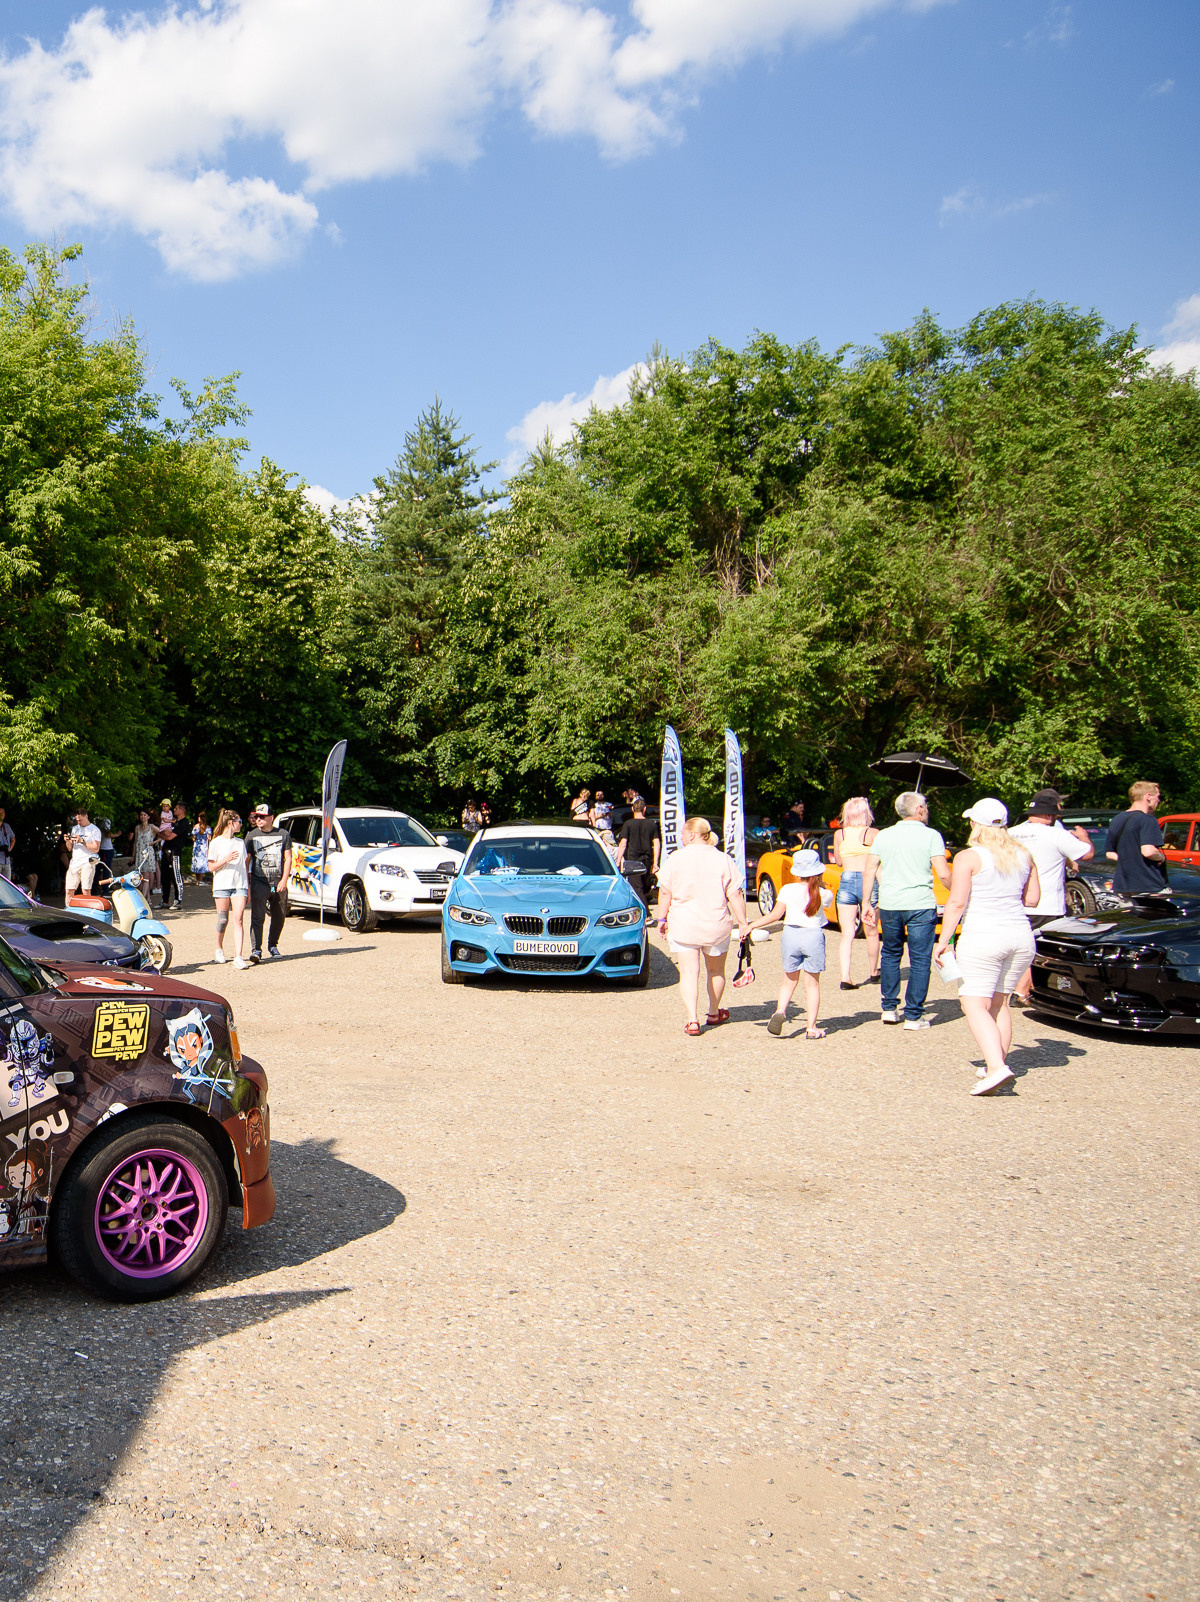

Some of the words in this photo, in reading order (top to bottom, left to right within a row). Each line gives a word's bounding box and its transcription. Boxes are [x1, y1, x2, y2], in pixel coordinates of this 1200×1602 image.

[515, 942, 576, 953] BUMEROVOD
[102, 1001, 125, 1009] PEW
[98, 1011, 146, 1031] PEW
[96, 1028, 144, 1049] PEW
[115, 1050, 139, 1061] PEW
[7, 1109, 70, 1150] YOU
